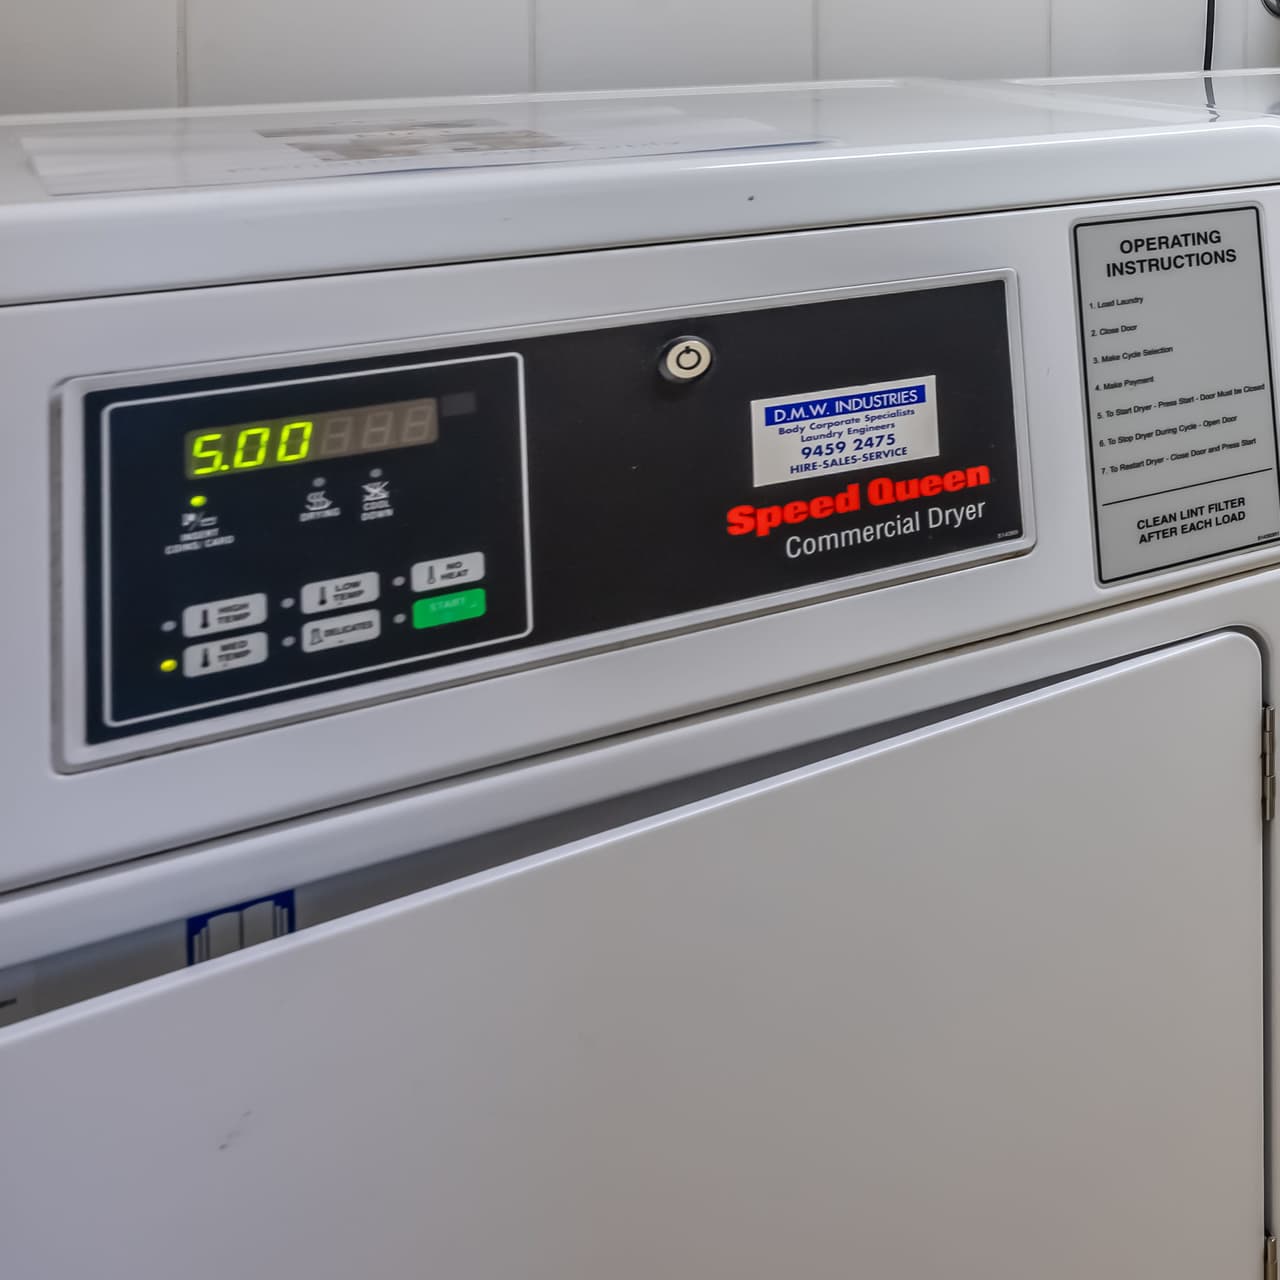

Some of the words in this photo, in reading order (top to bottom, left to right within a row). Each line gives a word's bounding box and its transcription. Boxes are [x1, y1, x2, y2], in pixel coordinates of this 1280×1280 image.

[1119, 230, 1222, 254] OPERATING
[1106, 248, 1237, 278] INSTRUCTIONS
[774, 402, 830, 423] D.M.W.
[835, 389, 918, 413] INDUSTRIES
[778, 424, 806, 435] Body
[809, 415, 861, 430] Corporate
[864, 408, 915, 422] Specialists
[800, 429, 843, 442] Laundry
[847, 422, 895, 436] Engineers
[192, 422, 313, 475] 5.00
[790, 446, 908, 474] HIRE-SALES-SERVICE
[801, 441, 846, 459] 9459
[852, 433, 896, 451] 2475
[726, 482, 861, 537] Speed
[867, 464, 991, 506] Queen
[1137, 512, 1177, 530] CLEAN
[1180, 506, 1205, 520] LINT
[1208, 497, 1246, 514] FILTER
[785, 511, 921, 559] Commercial
[928, 500, 986, 529] Dryer
[1139, 526, 1178, 544] AFTER
[1181, 518, 1212, 534] EACH
[1216, 510, 1246, 526] LOAD
[334, 581, 362, 592] LOW
